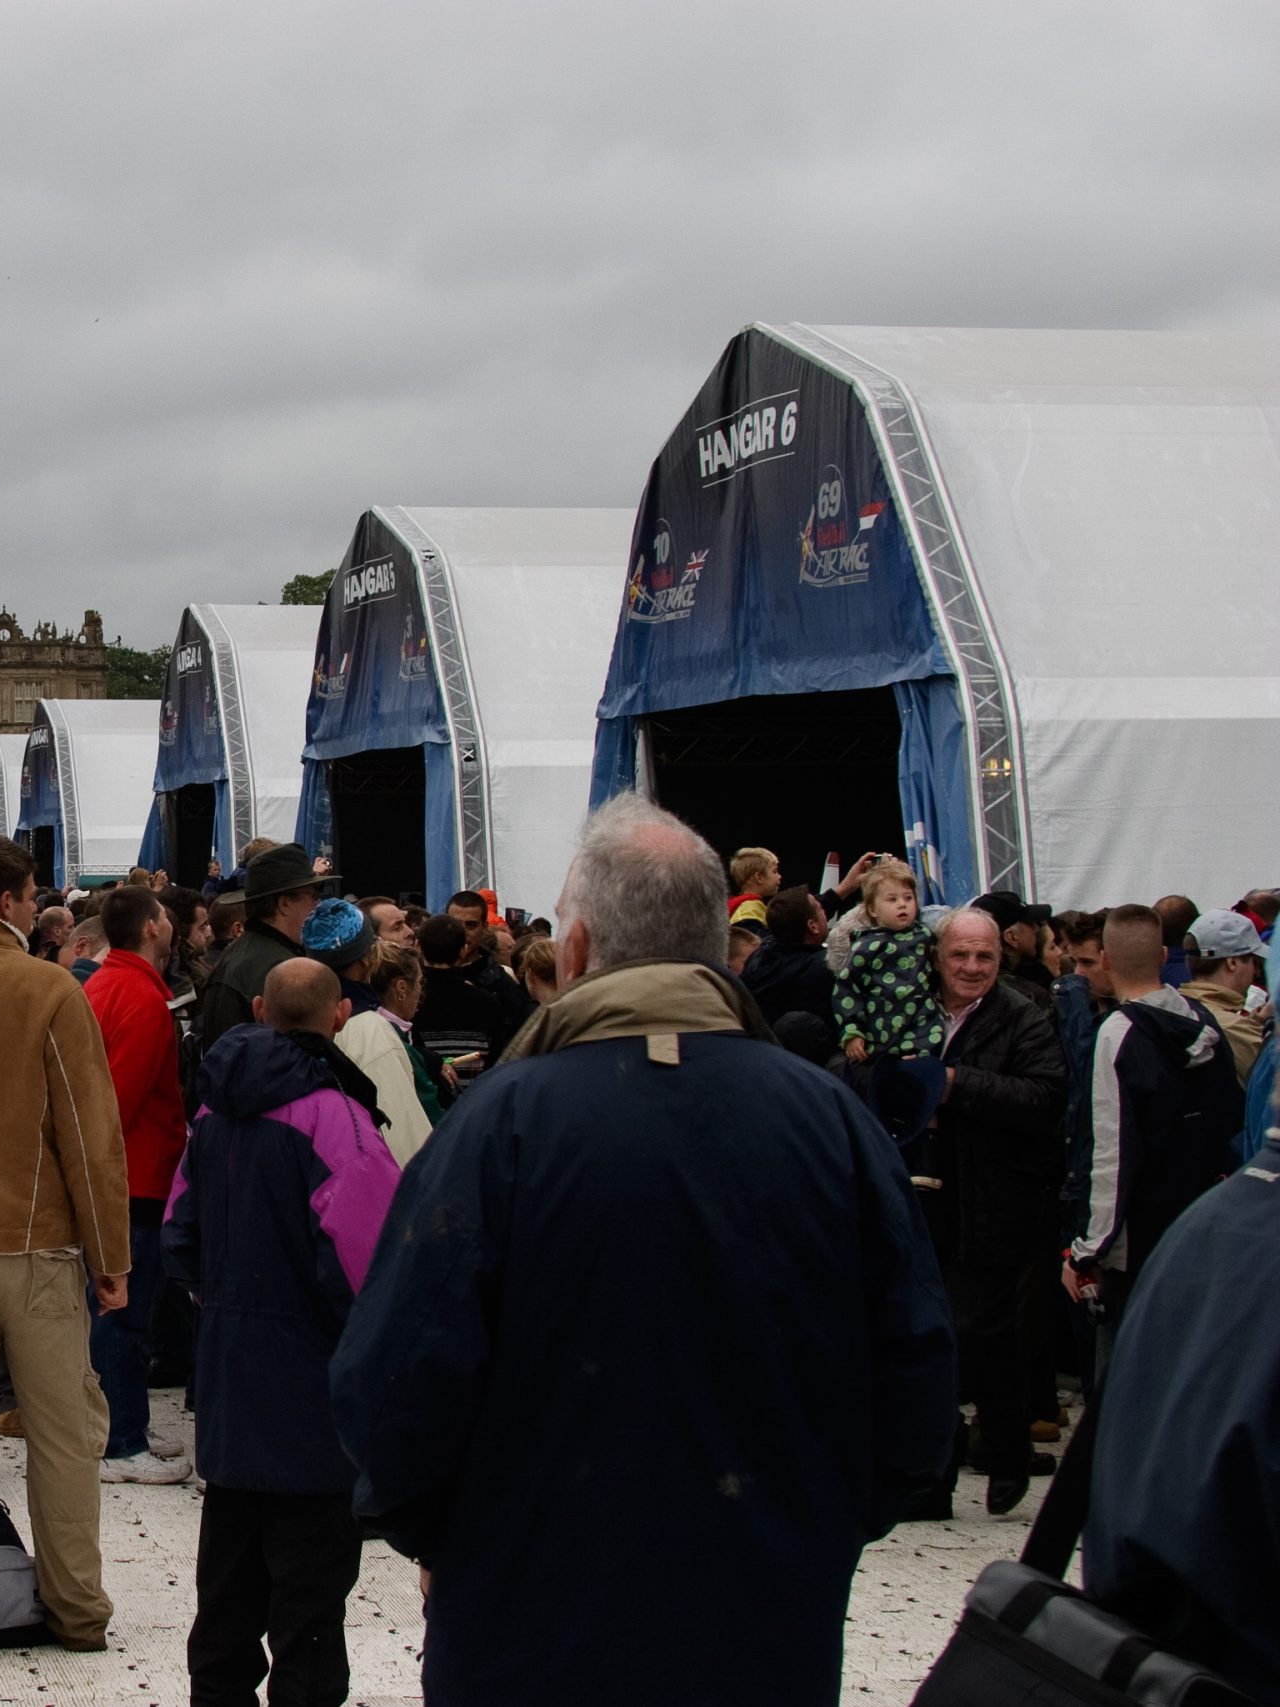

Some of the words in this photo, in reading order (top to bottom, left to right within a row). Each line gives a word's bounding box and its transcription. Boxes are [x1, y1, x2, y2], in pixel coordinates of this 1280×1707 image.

[698, 406, 776, 478] HANGAR
[780, 401, 798, 446] 6
[818, 479, 842, 519] 69
[653, 531, 670, 565] 10
[389, 561, 396, 590] 5
[667, 582, 697, 611] RACE
